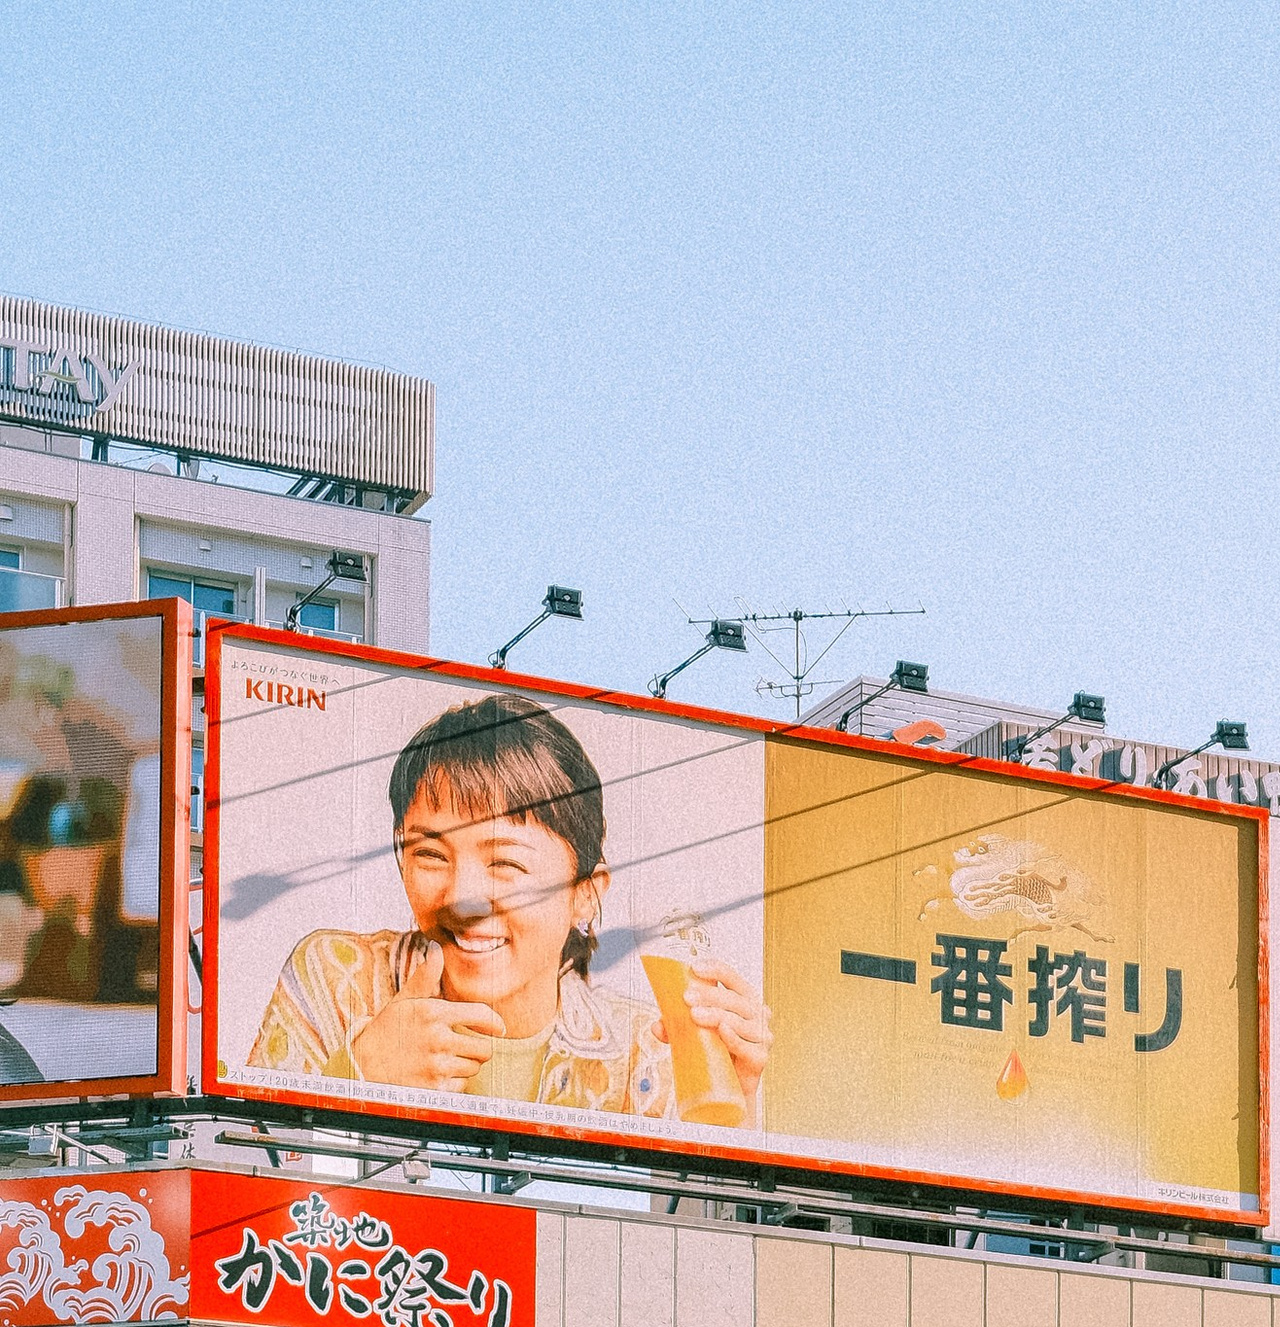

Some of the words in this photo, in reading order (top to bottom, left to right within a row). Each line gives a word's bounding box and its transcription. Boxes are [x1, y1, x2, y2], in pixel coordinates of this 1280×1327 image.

[231, 660, 341, 686] よろこびがつなぐ世界へ
[246, 678, 326, 711] KIRIN
[839, 932, 1184, 1054] 一番搾り
[1157, 1187, 1230, 1205] キリンビール株式会社
[286, 1192, 392, 1250] 築地
